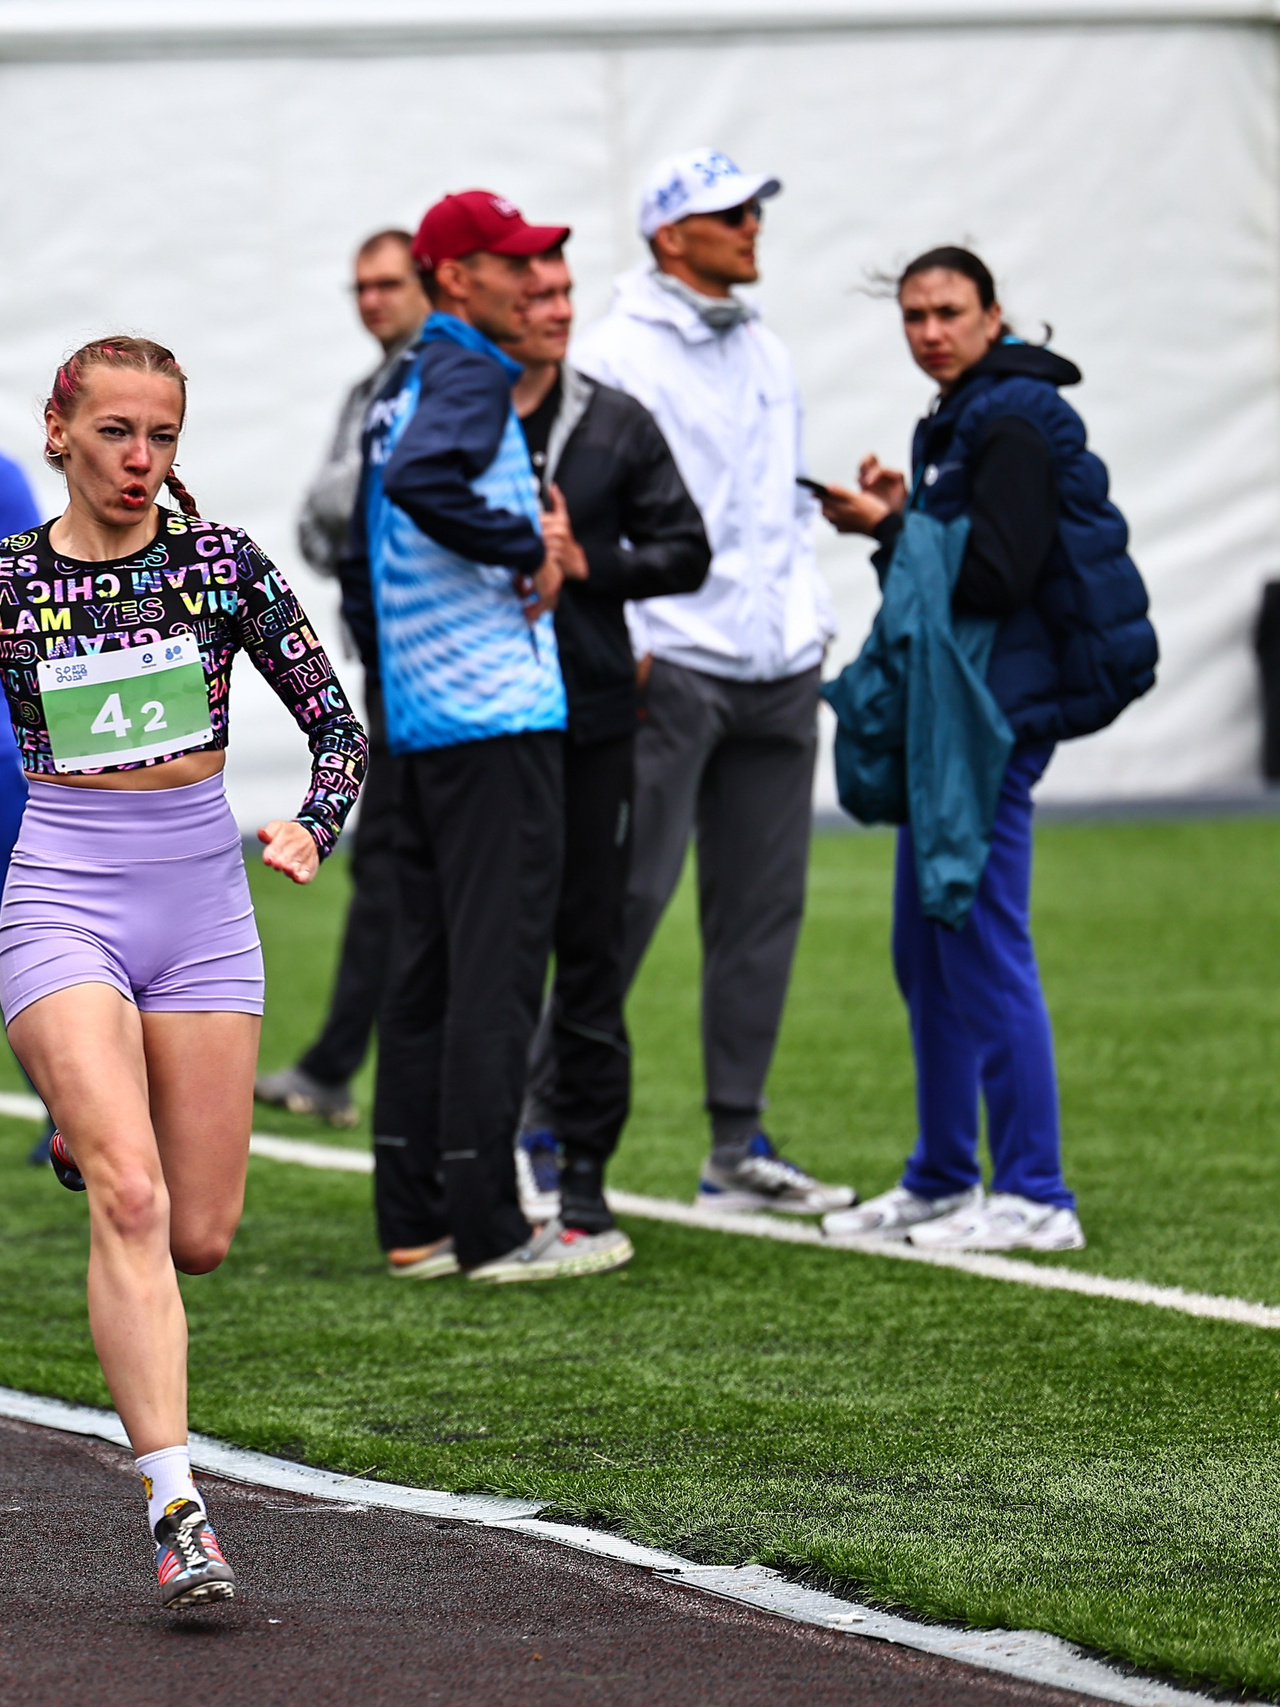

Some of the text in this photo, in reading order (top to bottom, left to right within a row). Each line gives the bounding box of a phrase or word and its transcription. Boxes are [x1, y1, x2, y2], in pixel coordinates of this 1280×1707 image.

[25, 573, 121, 604] CHIC
[131, 558, 237, 595] GLAM
[83, 597, 166, 629] YES
[90, 693, 133, 738] 4
[140, 700, 168, 733] 2
